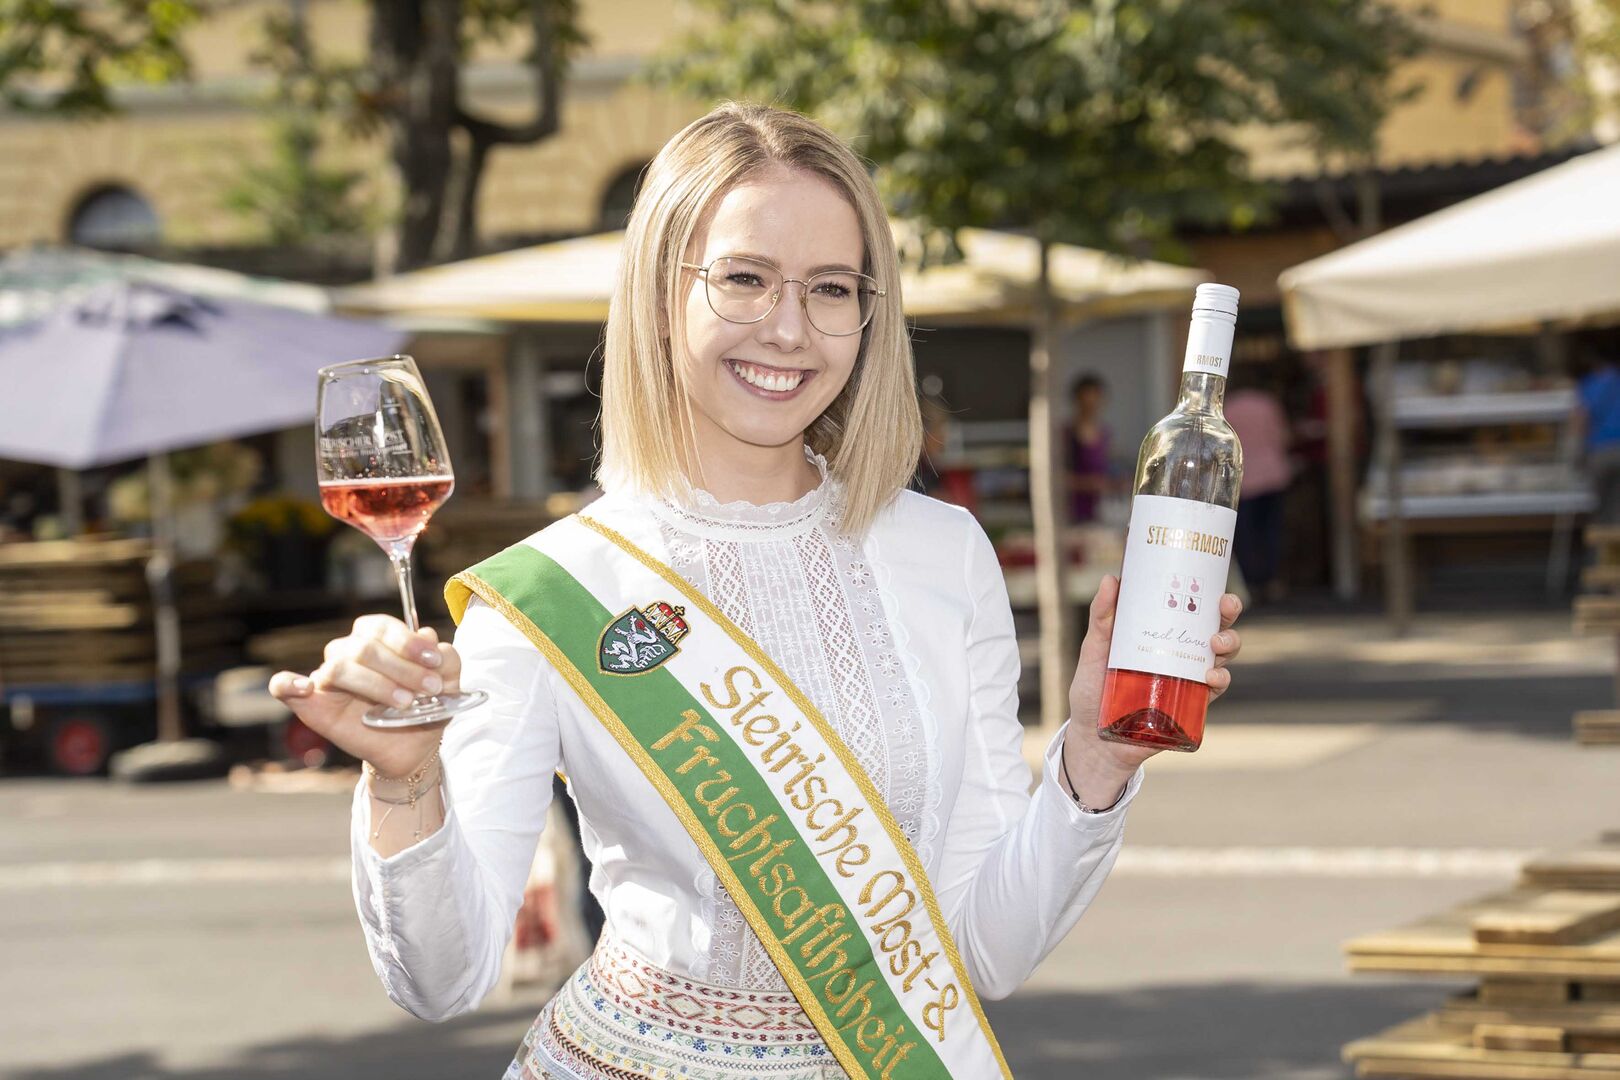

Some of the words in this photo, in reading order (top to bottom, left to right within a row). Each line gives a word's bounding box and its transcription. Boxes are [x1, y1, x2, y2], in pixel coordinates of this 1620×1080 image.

[1176, 630, 1208, 648] love
[700, 665, 871, 877] Steirische
[651, 708, 917, 1080] Fruchtsafthoheit
